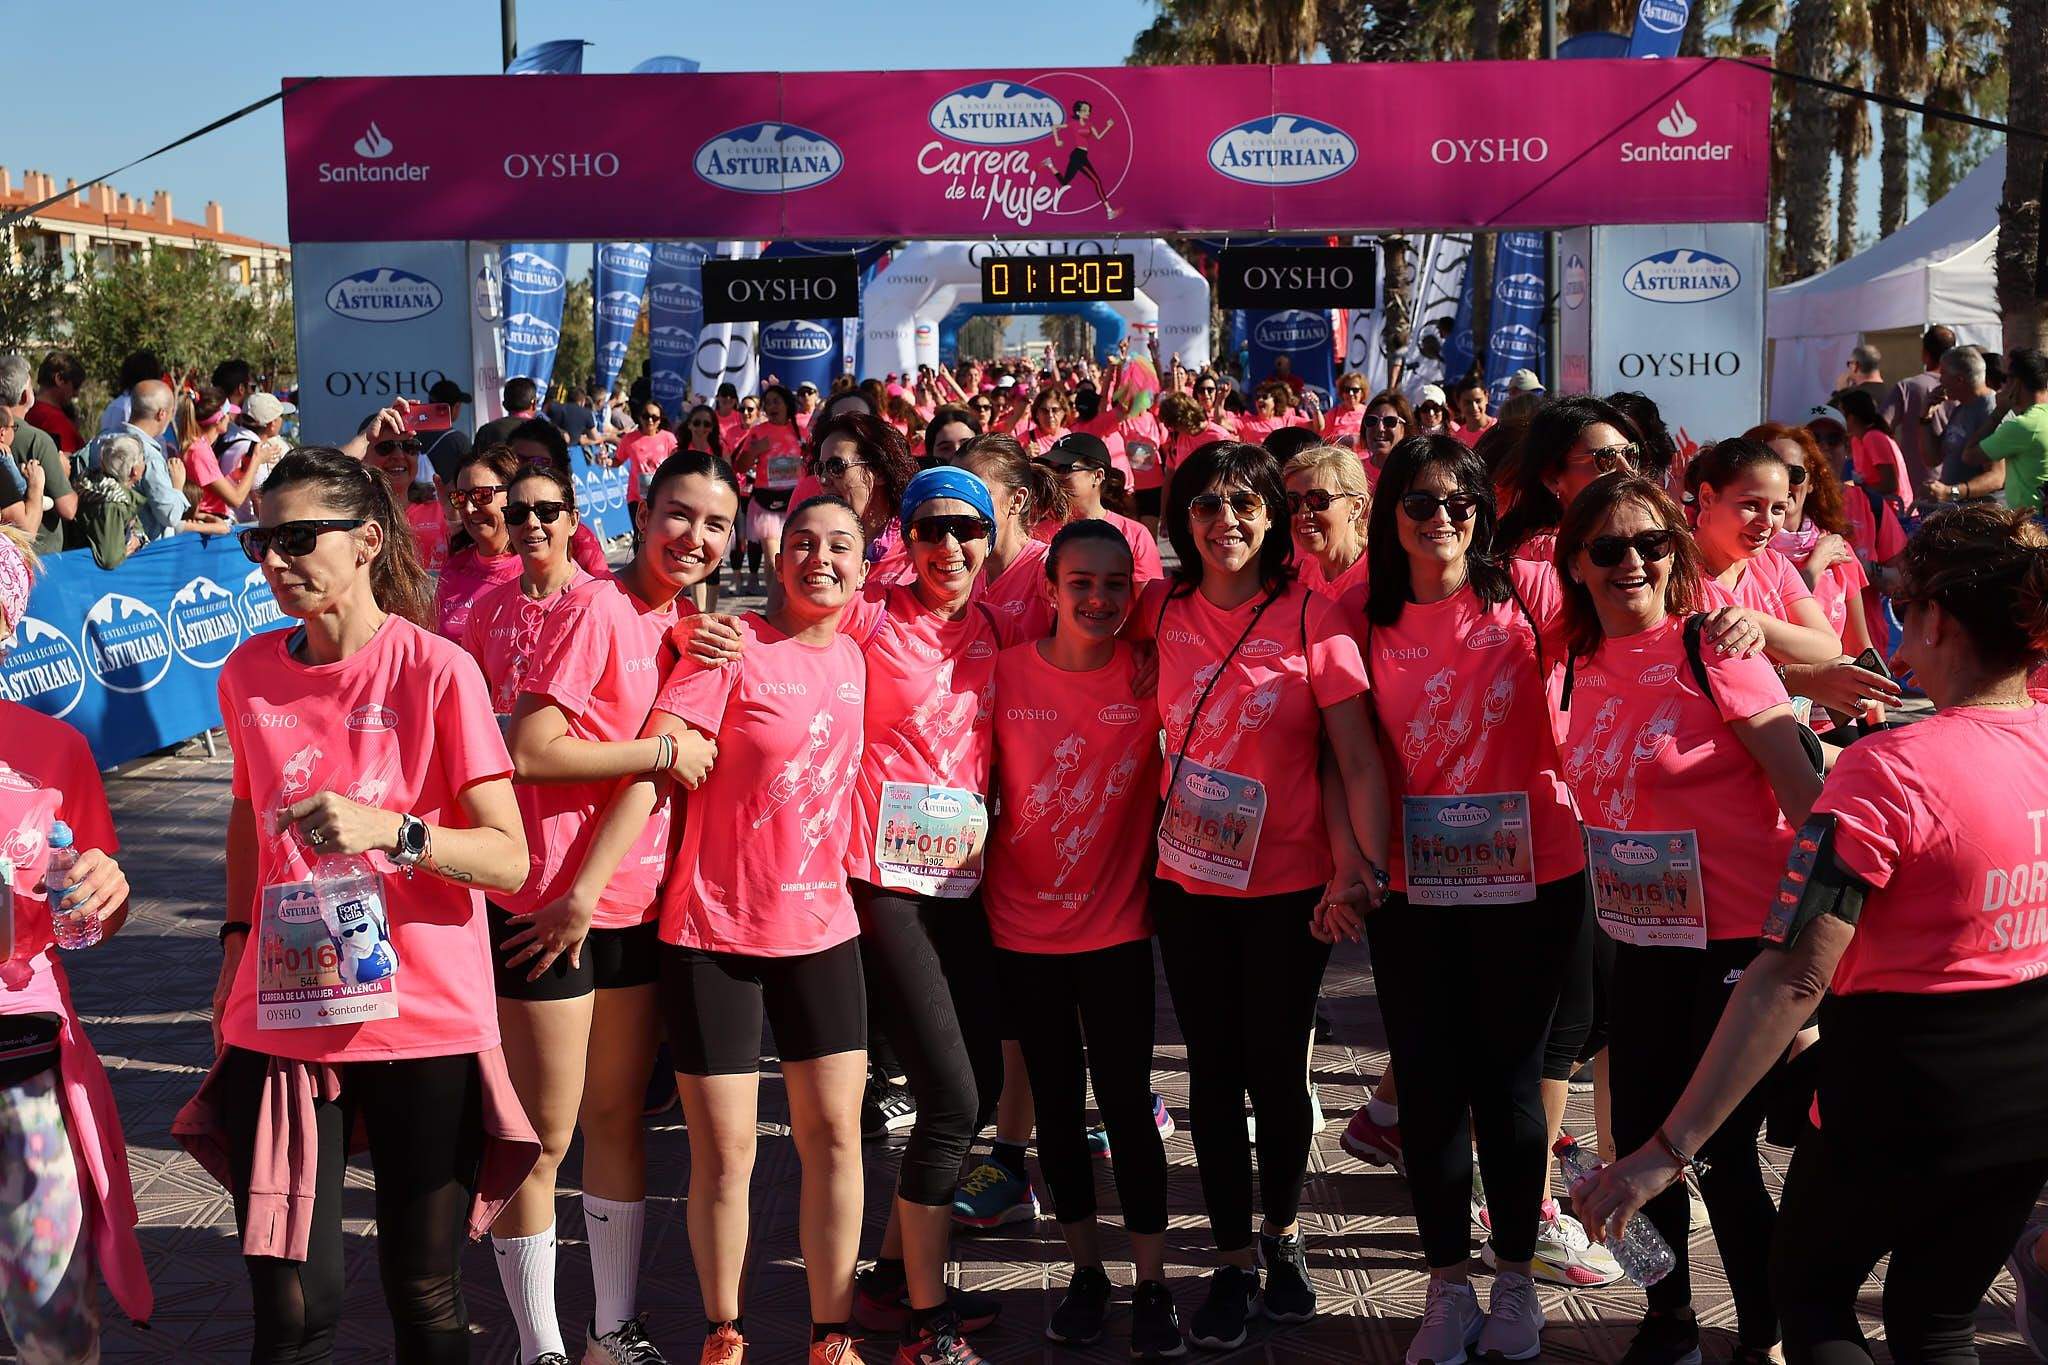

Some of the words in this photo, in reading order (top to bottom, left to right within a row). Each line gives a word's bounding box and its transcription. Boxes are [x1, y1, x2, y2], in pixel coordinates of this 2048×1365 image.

[940, 105, 1055, 129] ASTURIANA
[917, 140, 1031, 175] Carrera
[1221, 141, 1346, 168] ASTURIANA
[1431, 137, 1548, 164] OYSHO
[1620, 141, 1733, 162] Santander
[503, 152, 620, 179] OYSHO
[705, 149, 832, 176] ASTURIANA
[319, 162, 430, 183] Santander
[945, 176, 966, 199] de
[970, 175, 986, 199] la
[982, 170, 1072, 227] Mujer
[887, 274, 929, 285] OYSHO
[1243, 266, 1354, 290] OYSHO
[1632, 269, 1732, 291] ASTURIANA
[727, 276, 837, 303] OYSHO
[335, 289, 435, 309] ASTURIANA
[764, 336, 828, 350] ASTURIANA
[1618, 351, 1741, 378] OYSHO
[98, 626, 128, 641] CENTRAL
[175, 611, 238, 651] ASTURIANA
[1166, 630, 1206, 647] OYSHO
[4, 650, 36, 669] CENTRAL
[36, 642, 67, 659] LECHERA
[90, 632, 169, 675] ASTURIANA
[1382, 646, 1430, 661] OYSHO
[0, 656, 81, 702] ASTURIANA
[758, 682, 807, 696] OYSHO
[240, 712, 299, 729] OYSHO
[1006, 708, 1058, 722] OYSHO
[1186, 778, 1227, 799] ASTURIANA
[921, 800, 960, 813] ASTURIANA
[1440, 811, 1488, 822] ASTURIANA
[917, 834, 957, 854] 016
[925, 857, 944, 867] 1902
[1187, 845, 1207, 859] MUJER
[1212, 853, 1243, 868] VALENCIA
[1613, 847, 1656, 860] ASTURIANA
[1197, 865, 1235, 881] Santander
[1413, 877, 1442, 885] CARRERA
[1444, 877, 1453, 885] DE
[1464, 876, 1488, 884] MUJER
[1493, 874, 1526, 882] VALENCIA
[1456, 867, 1479, 875] 1905
[781, 882, 804, 891] CARRERA
[1421, 890, 1459, 899] OYSHO
[1483, 890, 1521, 898] Santander
[338, 903, 361, 914] Font
[340, 910, 363, 922] Vella
[1637, 917, 1661, 925] MUJER
[1666, 918, 1698, 926] VALENCIA
[1657, 931, 1695, 940] Santander
[285, 944, 337, 971] 016
[300, 976, 318, 987] 544
[261, 993, 285, 1002] CARRERA
[286, 992, 294, 1001] DE
[295, 991, 305, 999] LA
[307, 989, 334, 999] MUJER
[341, 983, 383, 996] VALENCIA
[266, 1008, 301, 1021] OYSHO
[329, 1003, 379, 1017] Santander
